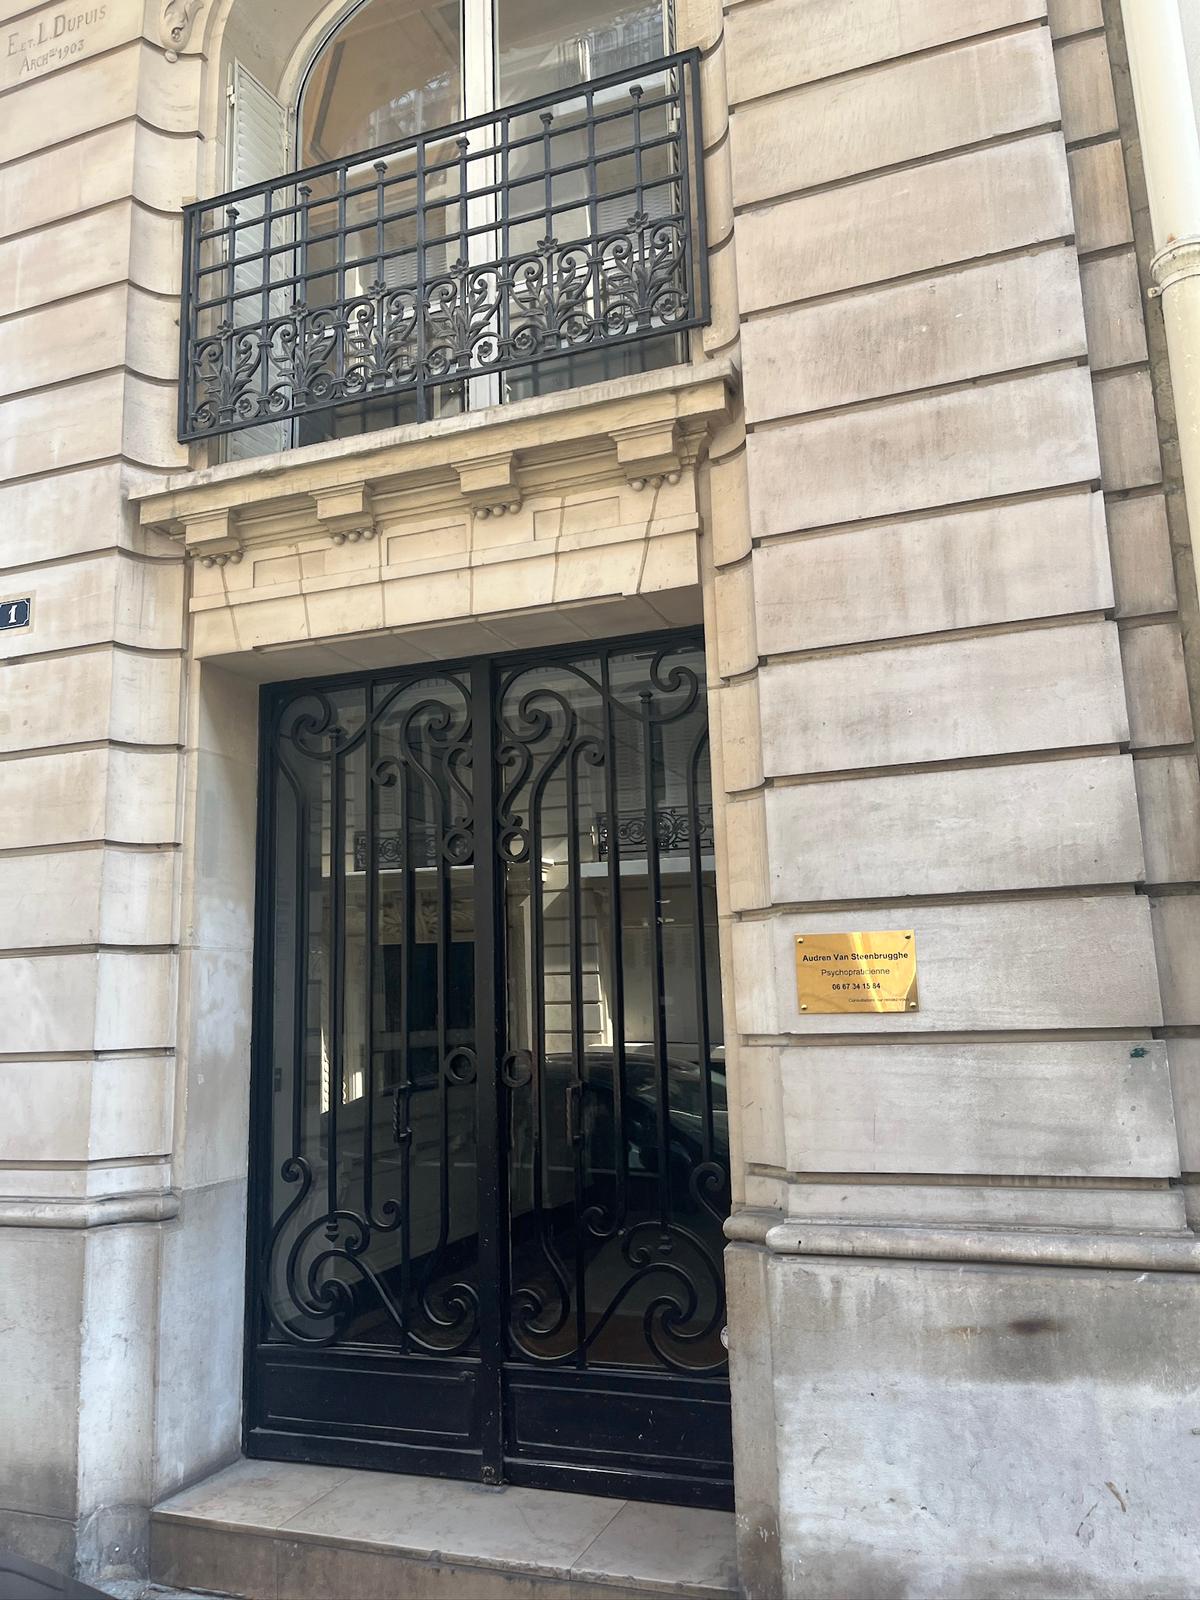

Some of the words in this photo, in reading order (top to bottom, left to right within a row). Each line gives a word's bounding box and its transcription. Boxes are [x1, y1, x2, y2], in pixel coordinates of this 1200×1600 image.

[58, 39, 85, 61] 1903
[9, 605, 17, 623] 1
[802, 954, 832, 962] Audren
[833, 953, 849, 961] Van
[851, 952, 908, 961] Steenbrugghe
[821, 968, 890, 977] Psychopraticienne
